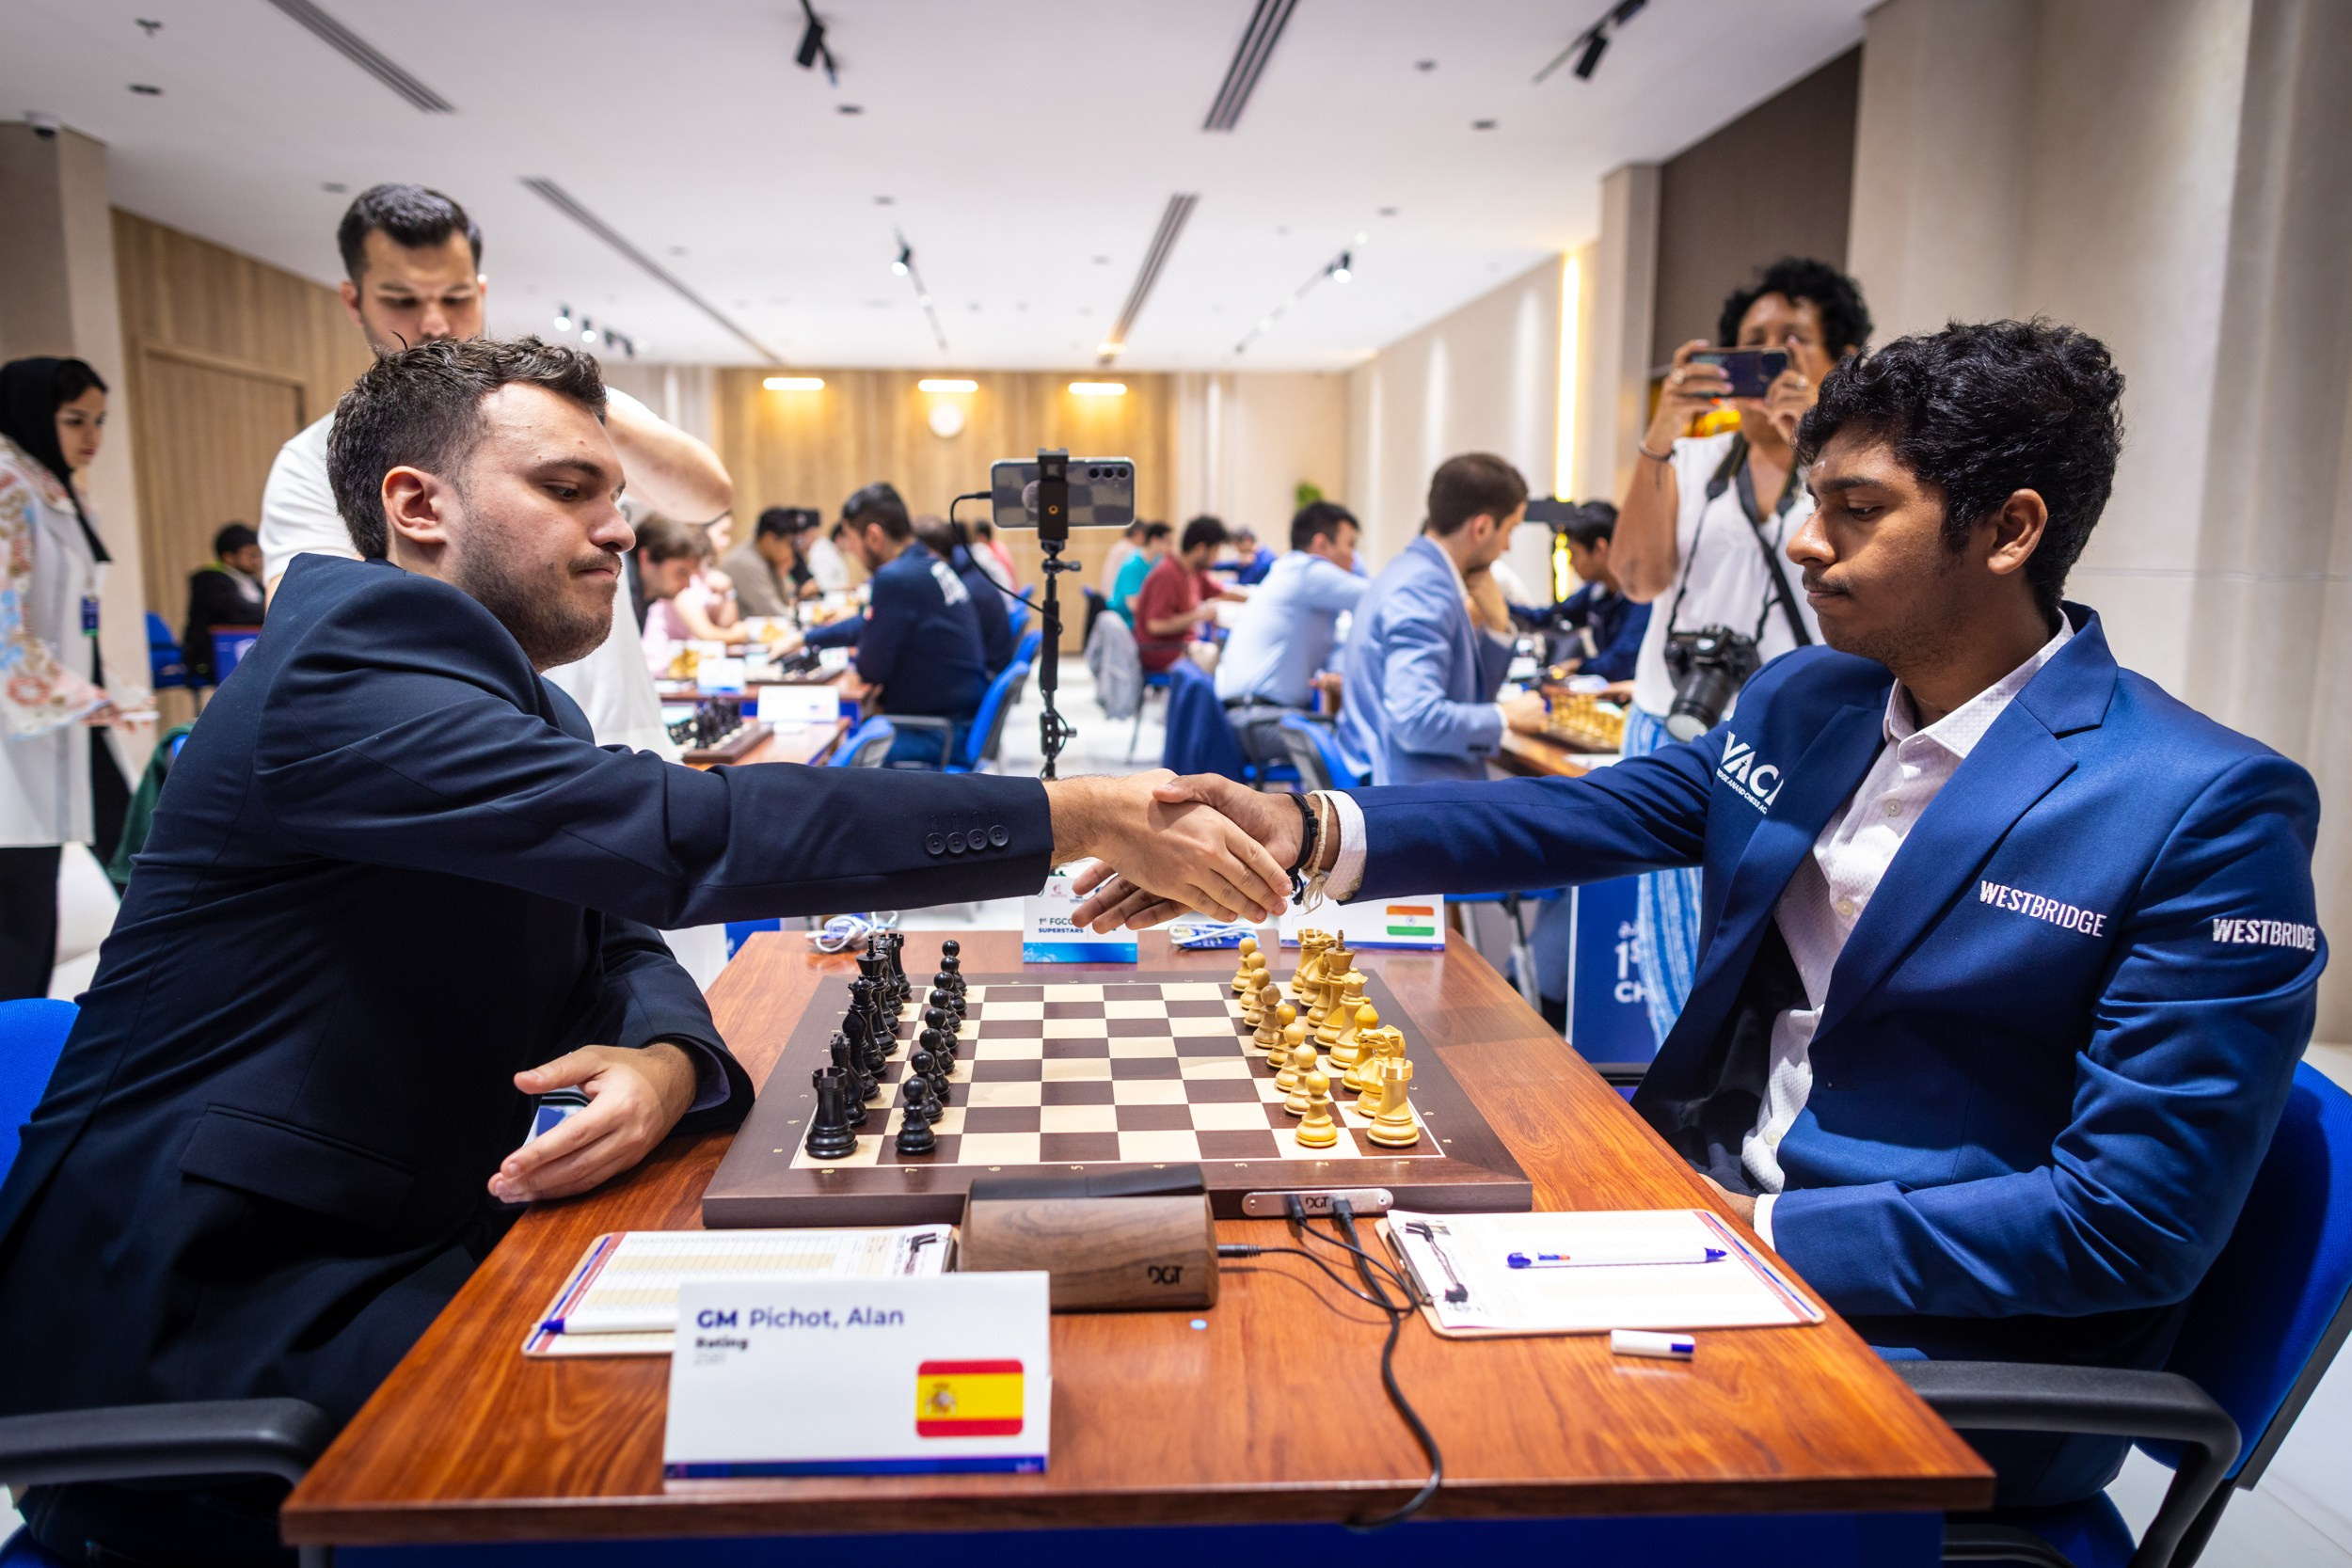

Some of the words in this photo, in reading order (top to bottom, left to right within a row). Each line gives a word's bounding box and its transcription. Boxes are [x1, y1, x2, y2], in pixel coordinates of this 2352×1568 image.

[1726, 779, 1746, 796] ANAND
[1744, 792, 1761, 808] CHESS
[1979, 880, 2106, 938] WESTBRIDGE
[2213, 918, 2315, 951] WESTBRIDGE
[1305, 1196, 1328, 1209] DGT
[1148, 1265, 1184, 1285] DGT
[697, 1308, 739, 1329] GM
[750, 1306, 839, 1330] Pichot,
[848, 1306, 904, 1327] Alan
